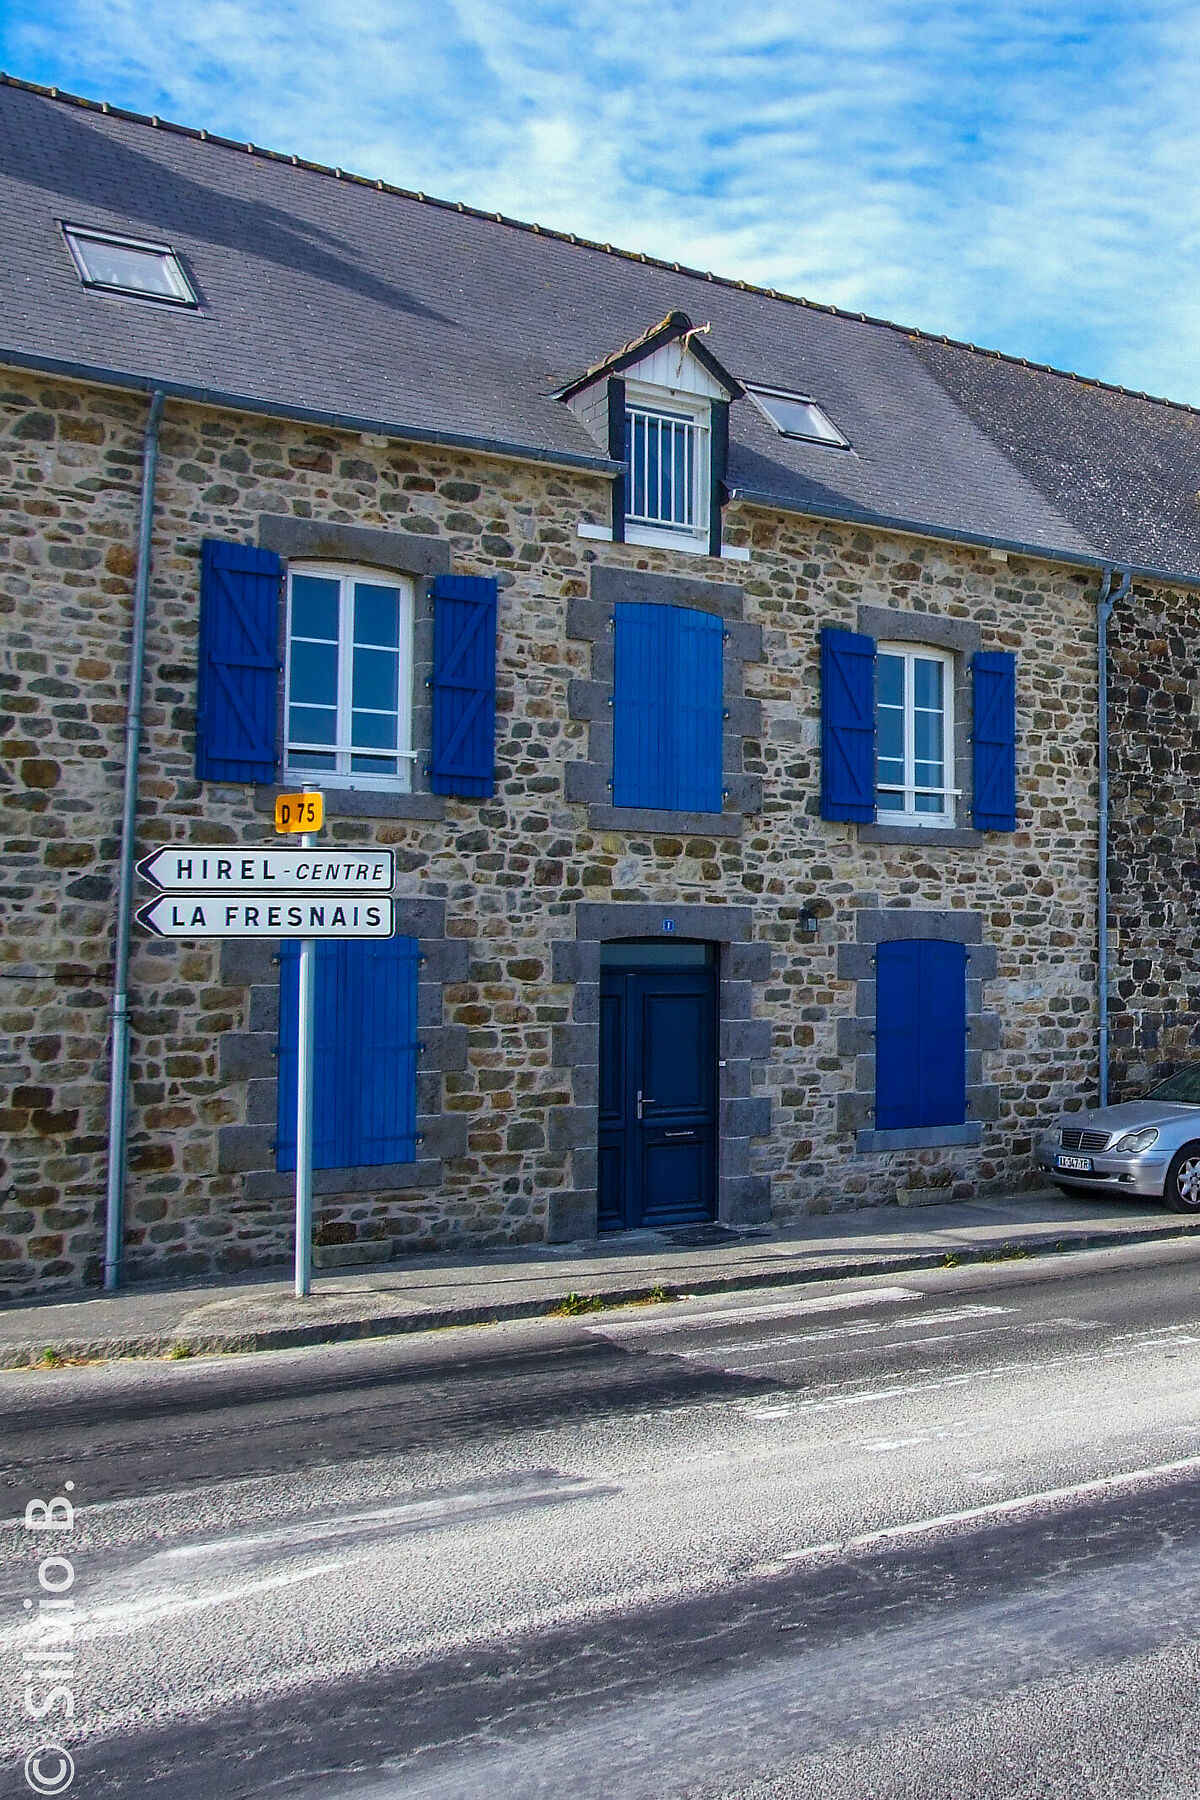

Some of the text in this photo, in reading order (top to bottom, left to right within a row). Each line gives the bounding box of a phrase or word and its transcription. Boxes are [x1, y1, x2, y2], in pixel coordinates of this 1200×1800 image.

[281, 802, 315, 825] D 75
[171, 905, 382, 928] LA FRESNAIS
